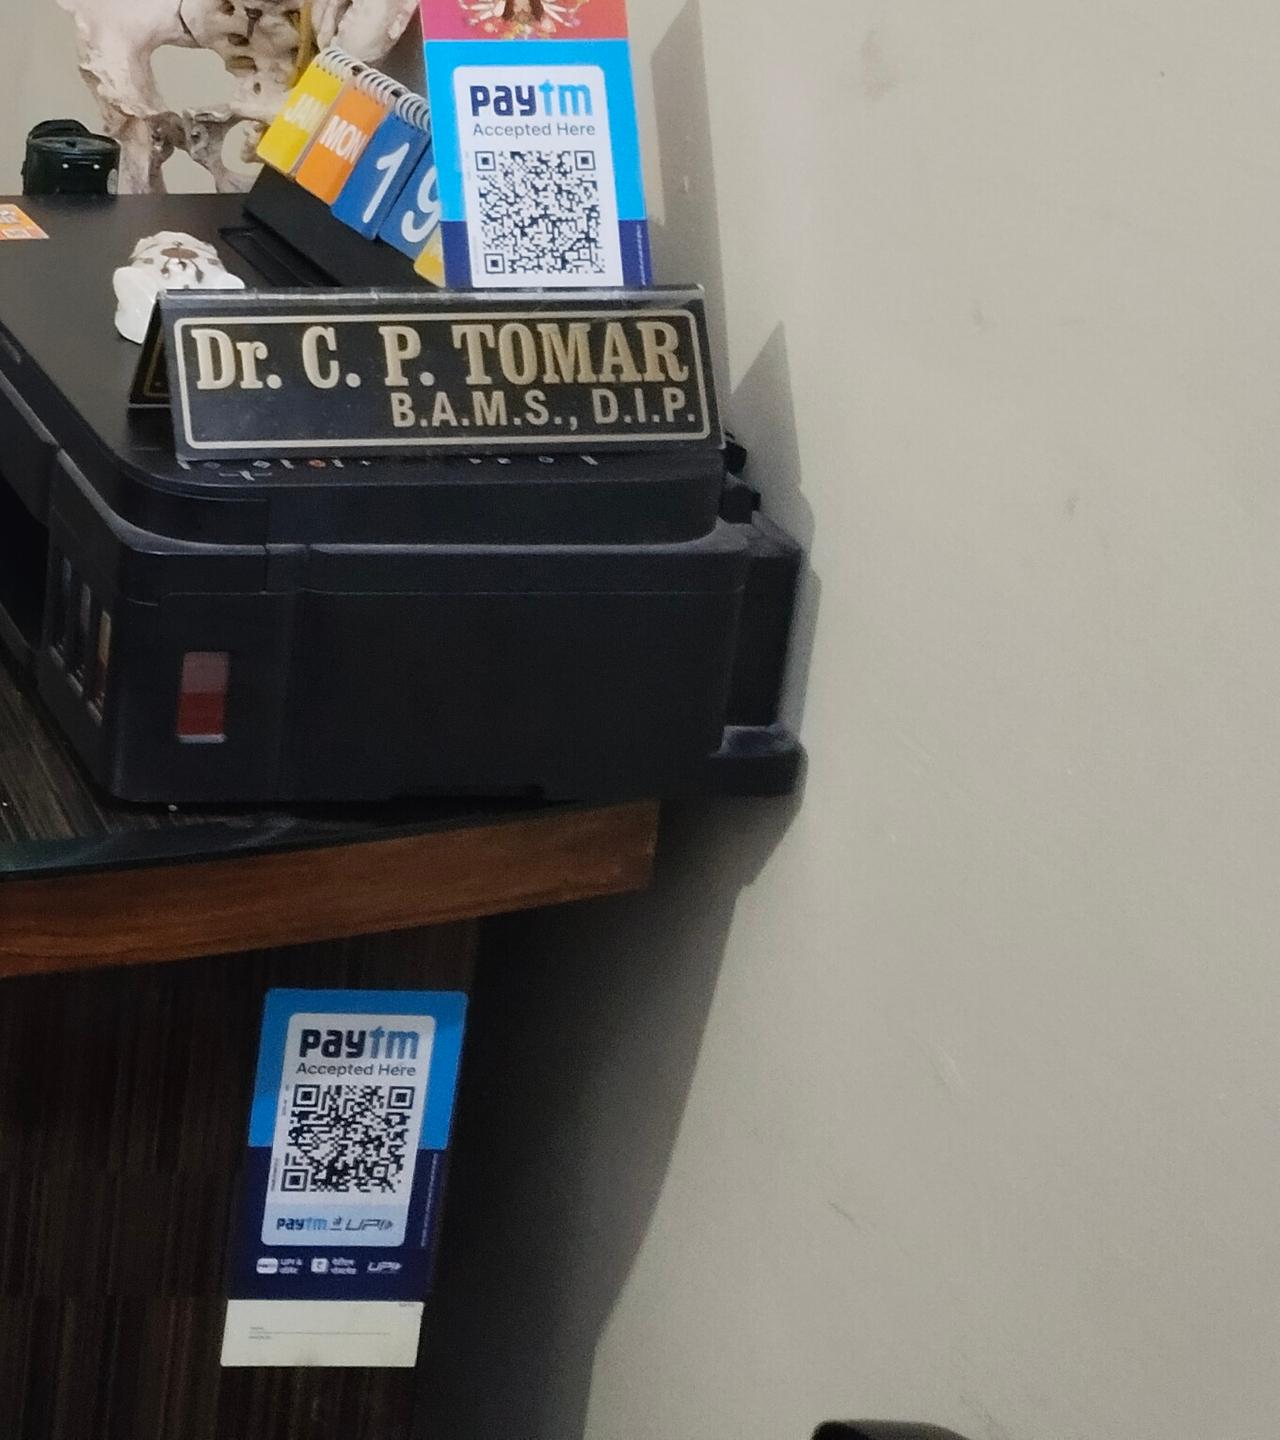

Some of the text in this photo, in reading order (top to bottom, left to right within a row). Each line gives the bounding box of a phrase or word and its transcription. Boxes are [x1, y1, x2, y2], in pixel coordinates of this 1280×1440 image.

[469, 79, 593, 117] paytm
[319, 115, 371, 164] MON
[473, 123, 596, 140] Accepted Here
[190, 320, 689, 391] Dr. C. P. TOMAR
[592, 387, 697, 426] D.I.P.
[299, 1025, 420, 1059] paytm
[295, 1062, 416, 1078] Accepted Here
[276, 1217, 328, 1231] paytm
